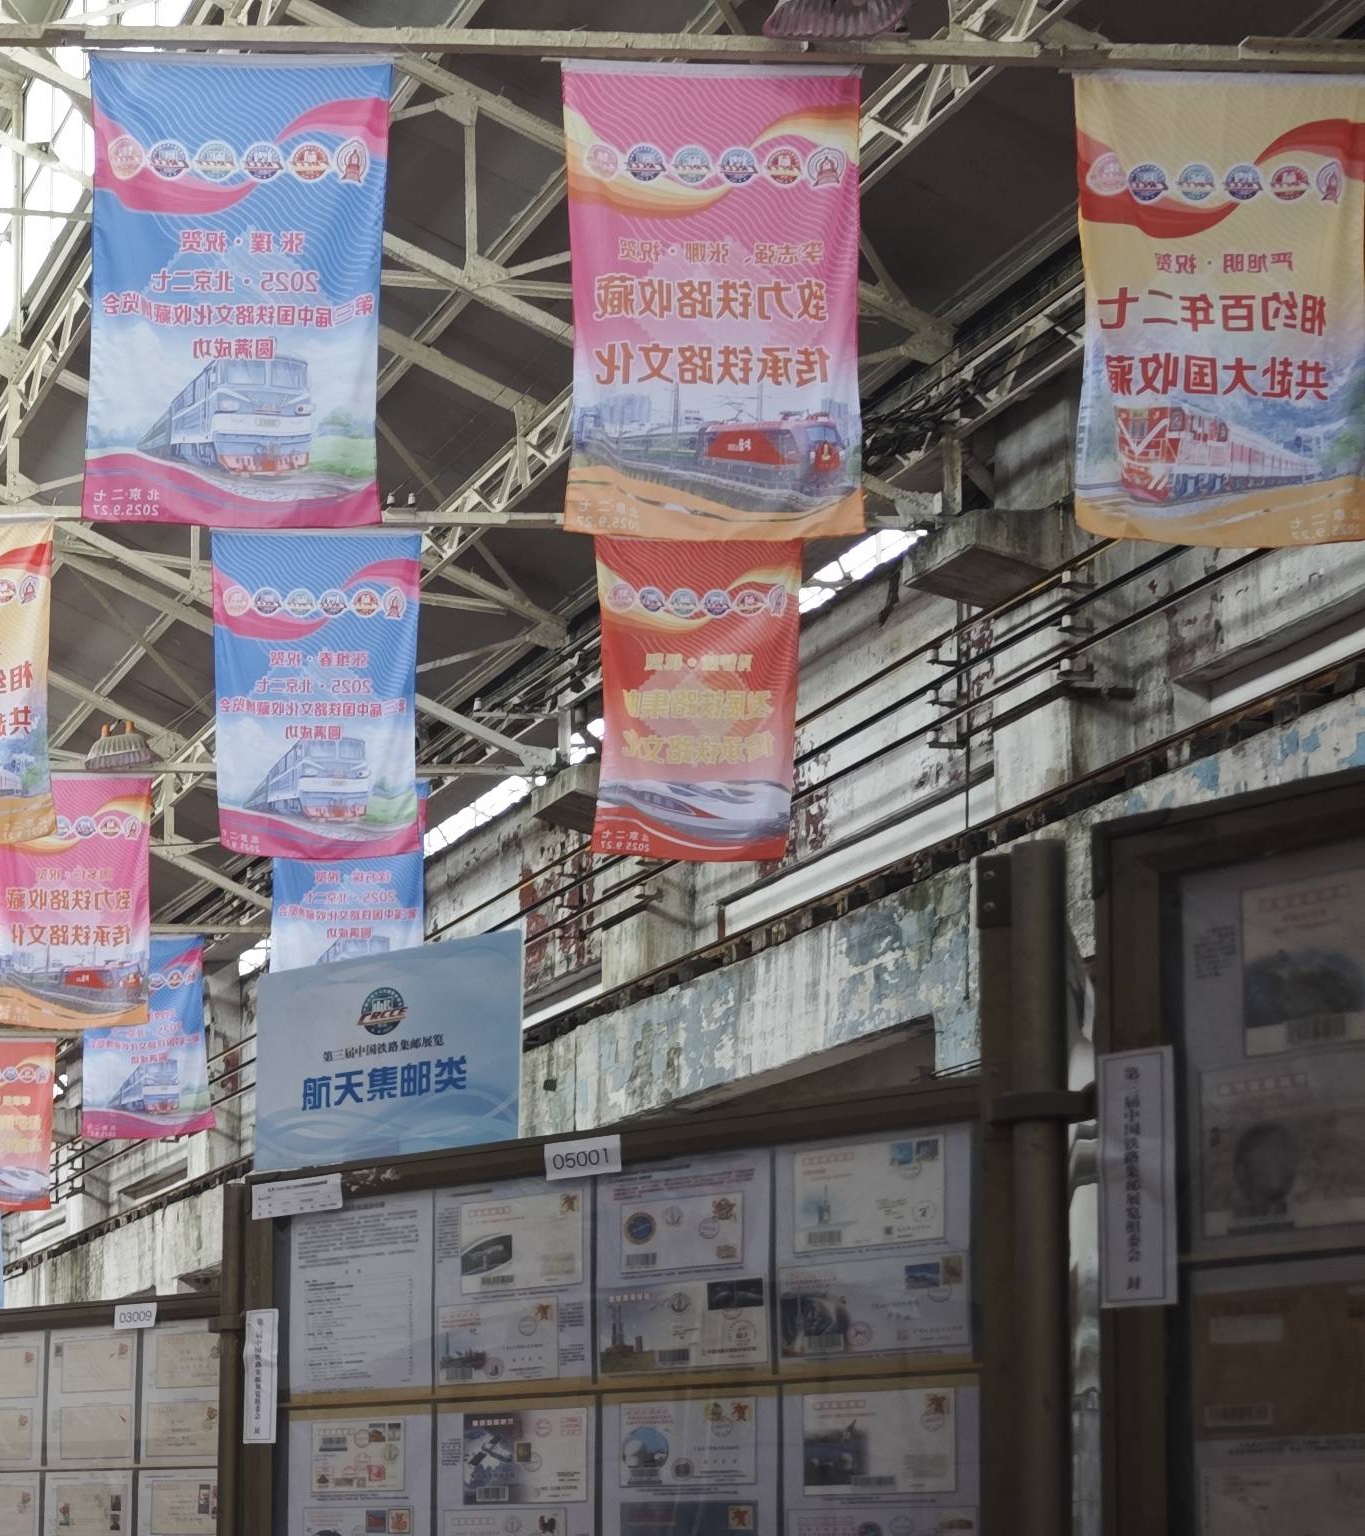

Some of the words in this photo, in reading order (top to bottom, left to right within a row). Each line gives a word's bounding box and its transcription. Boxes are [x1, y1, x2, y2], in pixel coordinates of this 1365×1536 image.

[302, 1055, 467, 1111] 航天集邮类
[552, 1148, 609, 1171] 05001
[119, 1310, 152, 1324] 03009
